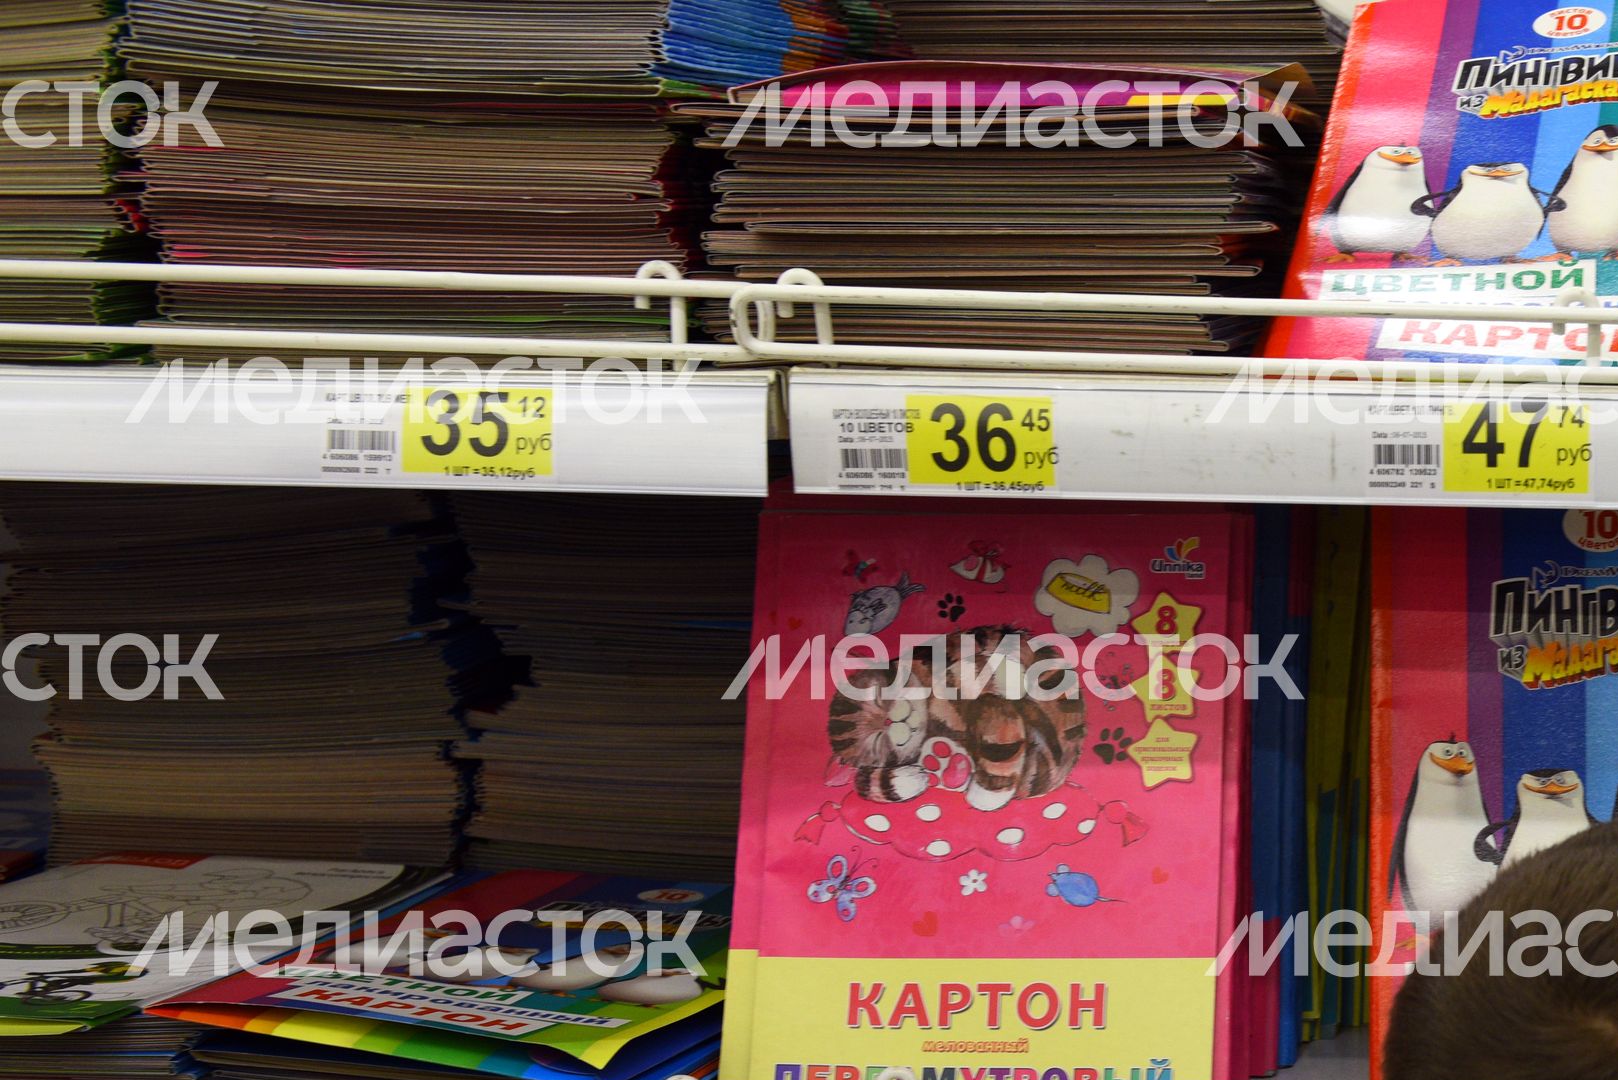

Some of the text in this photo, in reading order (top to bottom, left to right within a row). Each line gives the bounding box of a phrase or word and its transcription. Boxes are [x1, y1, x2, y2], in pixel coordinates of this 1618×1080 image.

[1553, 14, 1588, 31] 10
[1329, 259, 1586, 296] ЦВЕТНОЙ
[518, 396, 546, 418] 12
[1556, 406, 1585, 428] 74
[421, 390, 509, 457] 35
[840, 422, 914, 434] 10 ЦВЕТОВ
[1021, 409, 1050, 432] 45
[516, 433, 552, 454] руб
[931, 403, 1016, 472] 36
[1462, 400, 1549, 468] 47
[1024, 446, 1059, 468] руб
[1557, 444, 1592, 465] руб
[1151, 558, 1204, 574] Unnika
[1155, 605, 1178, 637] 8
[297, 988, 528, 1031] КАРТОН
[847, 981, 1107, 1030] КАРТОН
[922, 1037, 1029, 1054] мелованный
